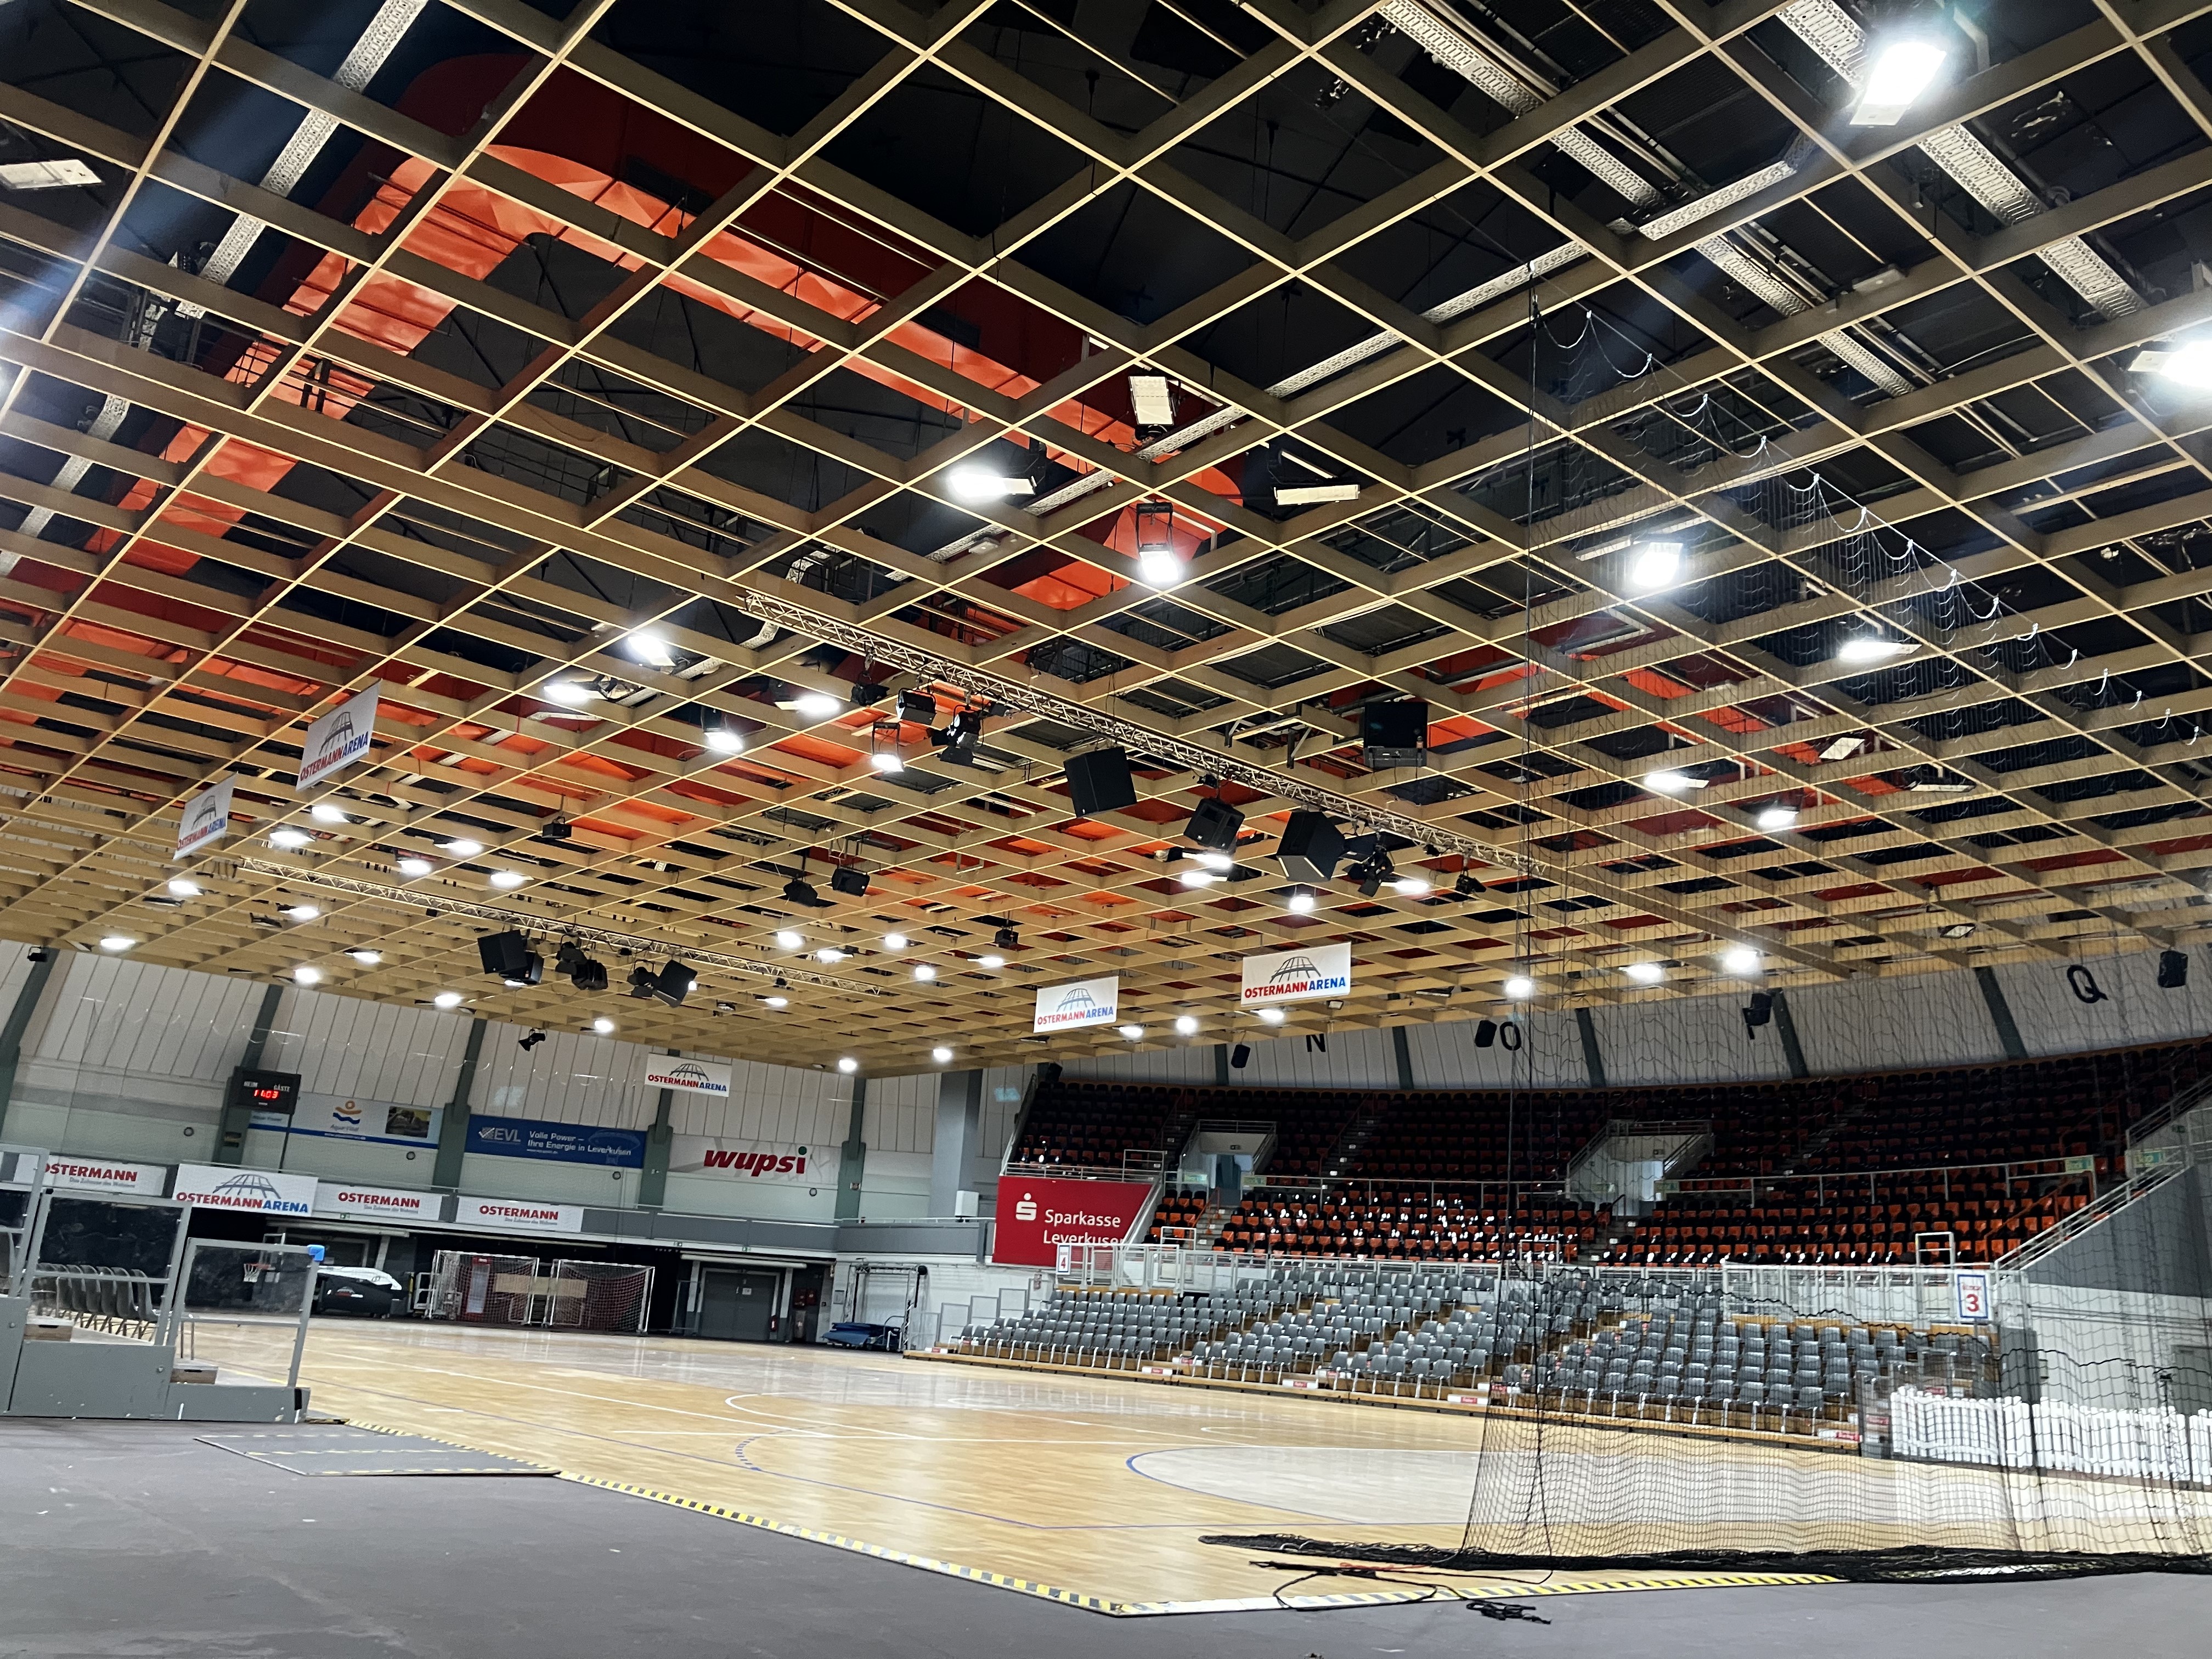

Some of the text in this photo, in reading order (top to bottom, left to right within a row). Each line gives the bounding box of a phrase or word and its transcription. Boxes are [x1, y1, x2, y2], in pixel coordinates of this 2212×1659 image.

[300, 731, 369, 781] OSTERMANNARENA
[1244, 977, 1346, 998] OSTERMANNARENA
[2067, 964, 2108, 1003] Q
[1037, 1006, 1114, 1025] OSTERMANNARENA
[1306, 1033, 1326, 1052] N
[648, 1074, 727, 1092] OSTERMANNARENA
[494, 1127, 521, 1142] EVL
[551, 1133, 576, 1142] Power
[528, 1139, 544, 1148] Ihre
[546, 1141, 575, 1152] Energie
[704, 1146, 807, 1177] wupsi
[176, 1192, 308, 1213] OSTERMANNARENA
[338, 1192, 420, 1208] OSTERMANN
[479, 1205, 559, 1220] OSTERMANN
[1045, 1209, 1121, 1228] Sparkasse
[1060, 1257, 1066, 1269] 4
[1966, 1293, 1979, 1312] 3
